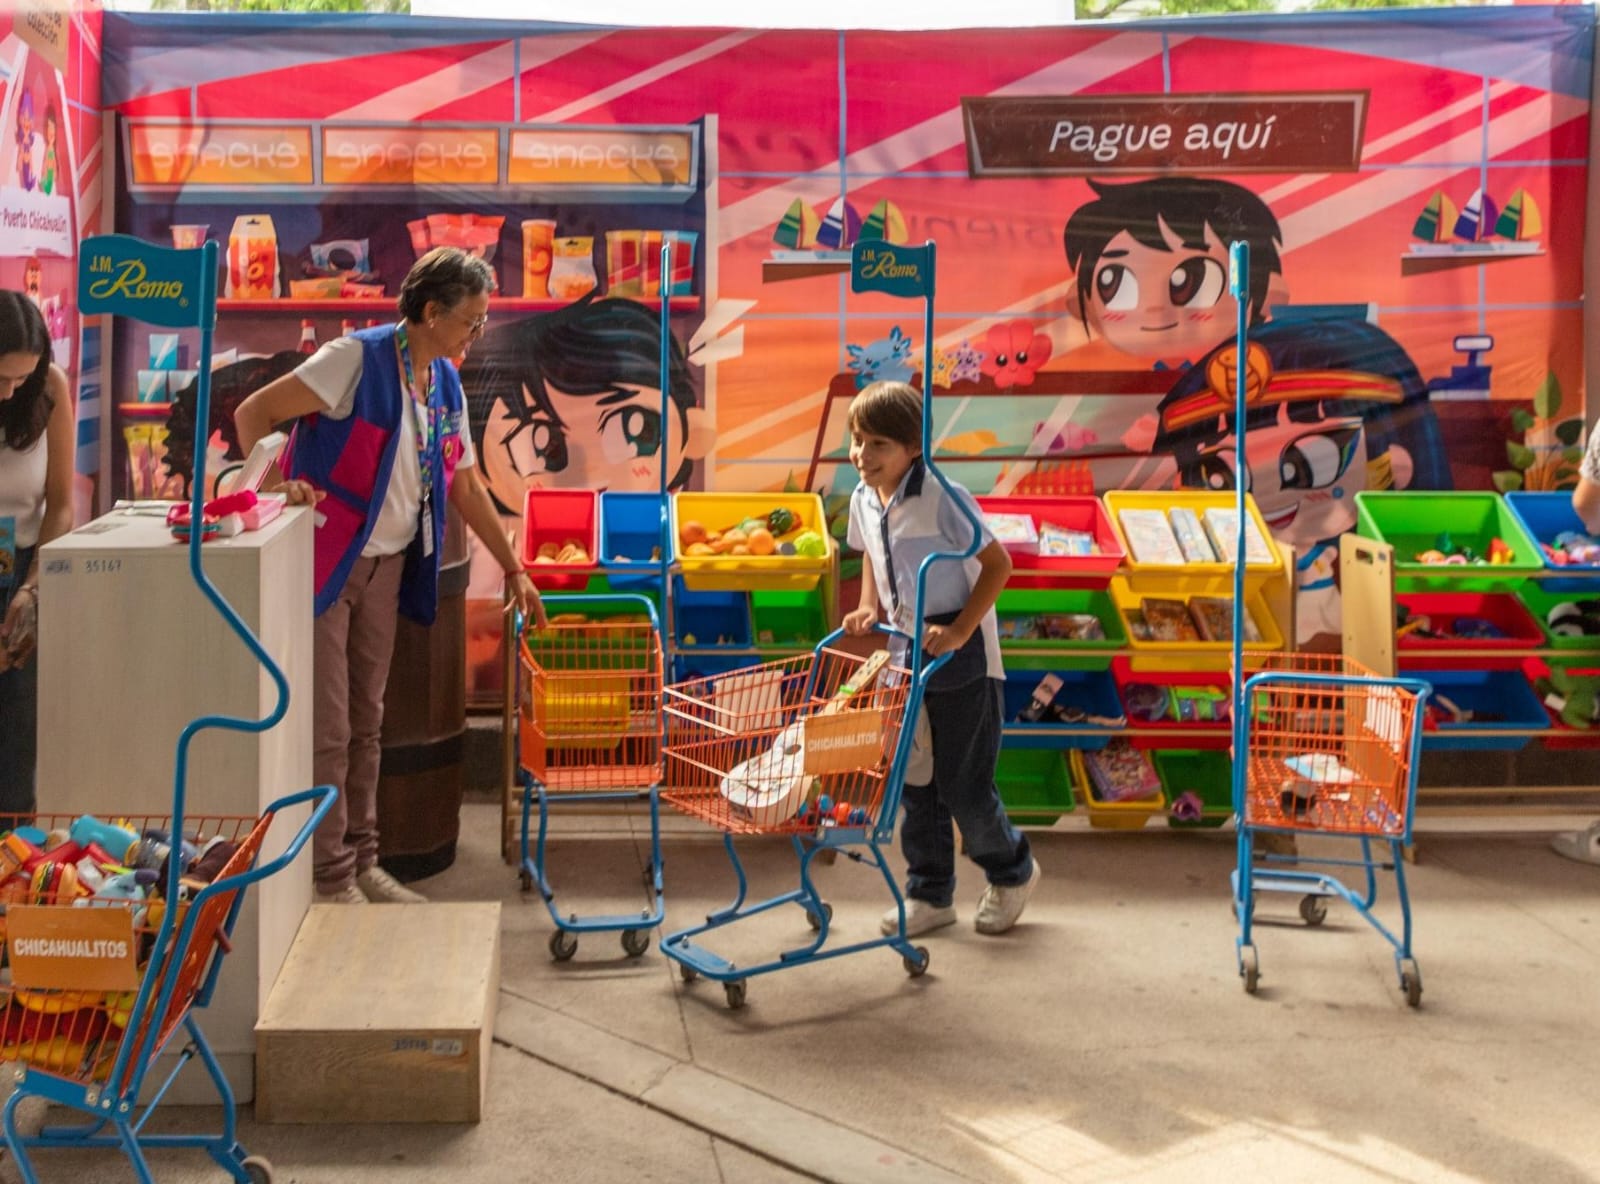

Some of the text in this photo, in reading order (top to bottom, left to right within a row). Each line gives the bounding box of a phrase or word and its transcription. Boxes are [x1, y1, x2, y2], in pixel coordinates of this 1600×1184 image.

[1049, 115, 1277, 162] Pague aquí
[3, 207, 28, 229] Puerto
[89, 255, 115, 274] J.M.
[861, 251, 918, 279] Romo
[89, 258, 184, 299] Romo
[807, 730, 878, 753] CHICAHUALITOS
[14, 938, 128, 958] CHICAHUALITOS
